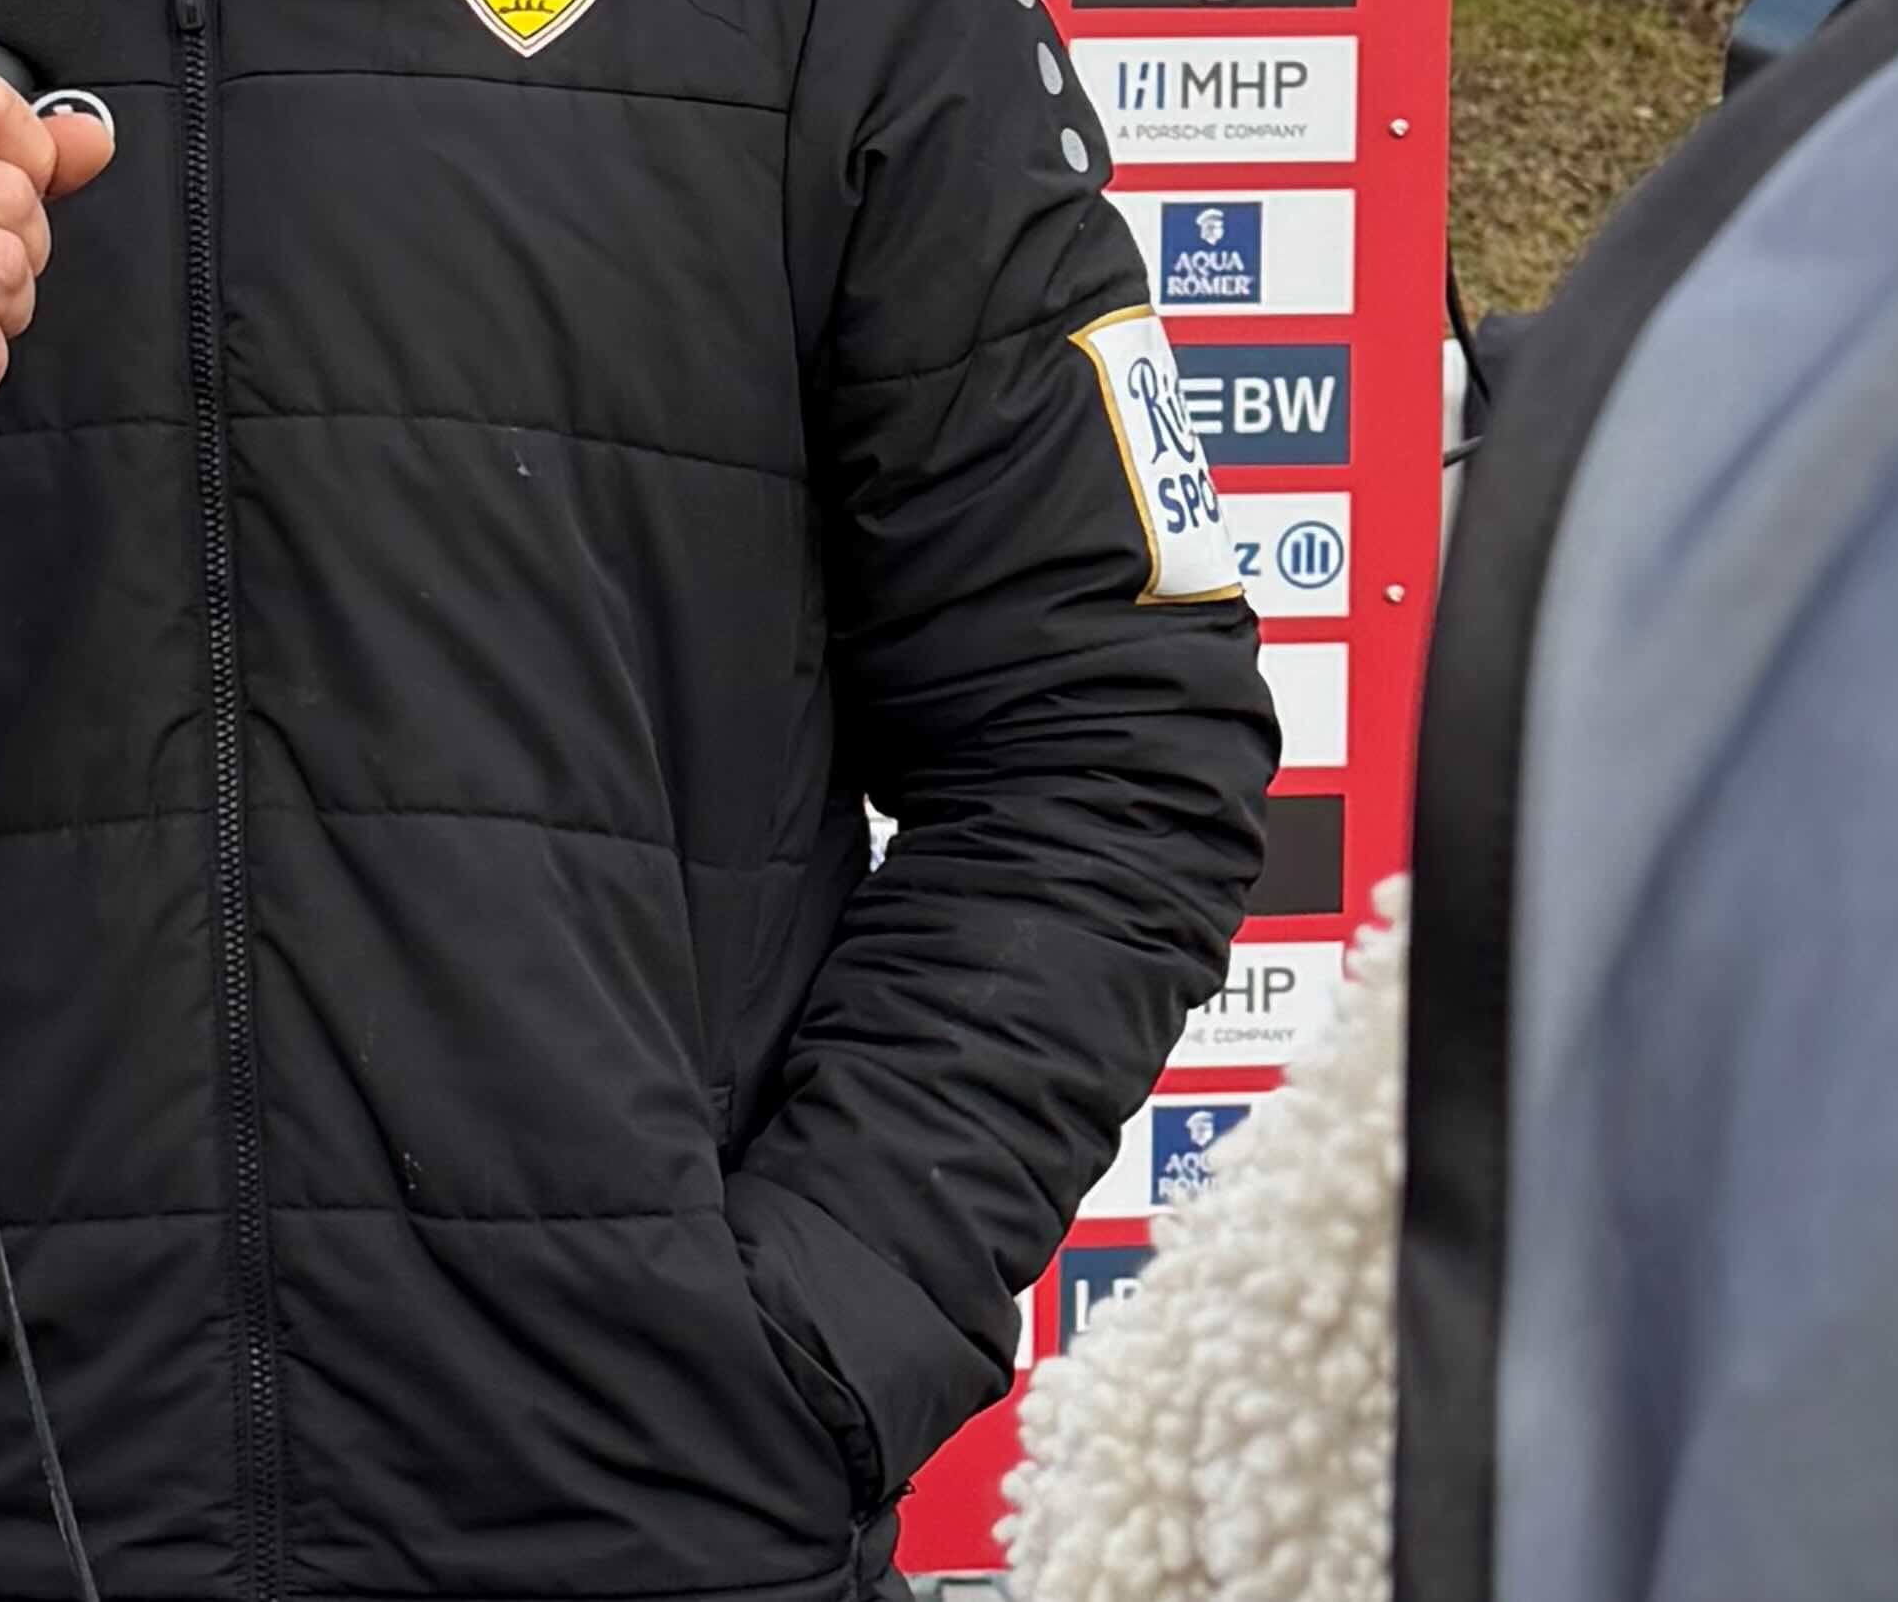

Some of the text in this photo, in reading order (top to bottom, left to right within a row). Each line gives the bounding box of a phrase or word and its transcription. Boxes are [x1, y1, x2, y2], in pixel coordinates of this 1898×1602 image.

[1181, 61, 1308, 109] MHP
[1136, 124, 1216, 140] PORSCHE
[1224, 124, 1308, 140] COMPANY
[1174, 251, 1245, 274] AQUA
